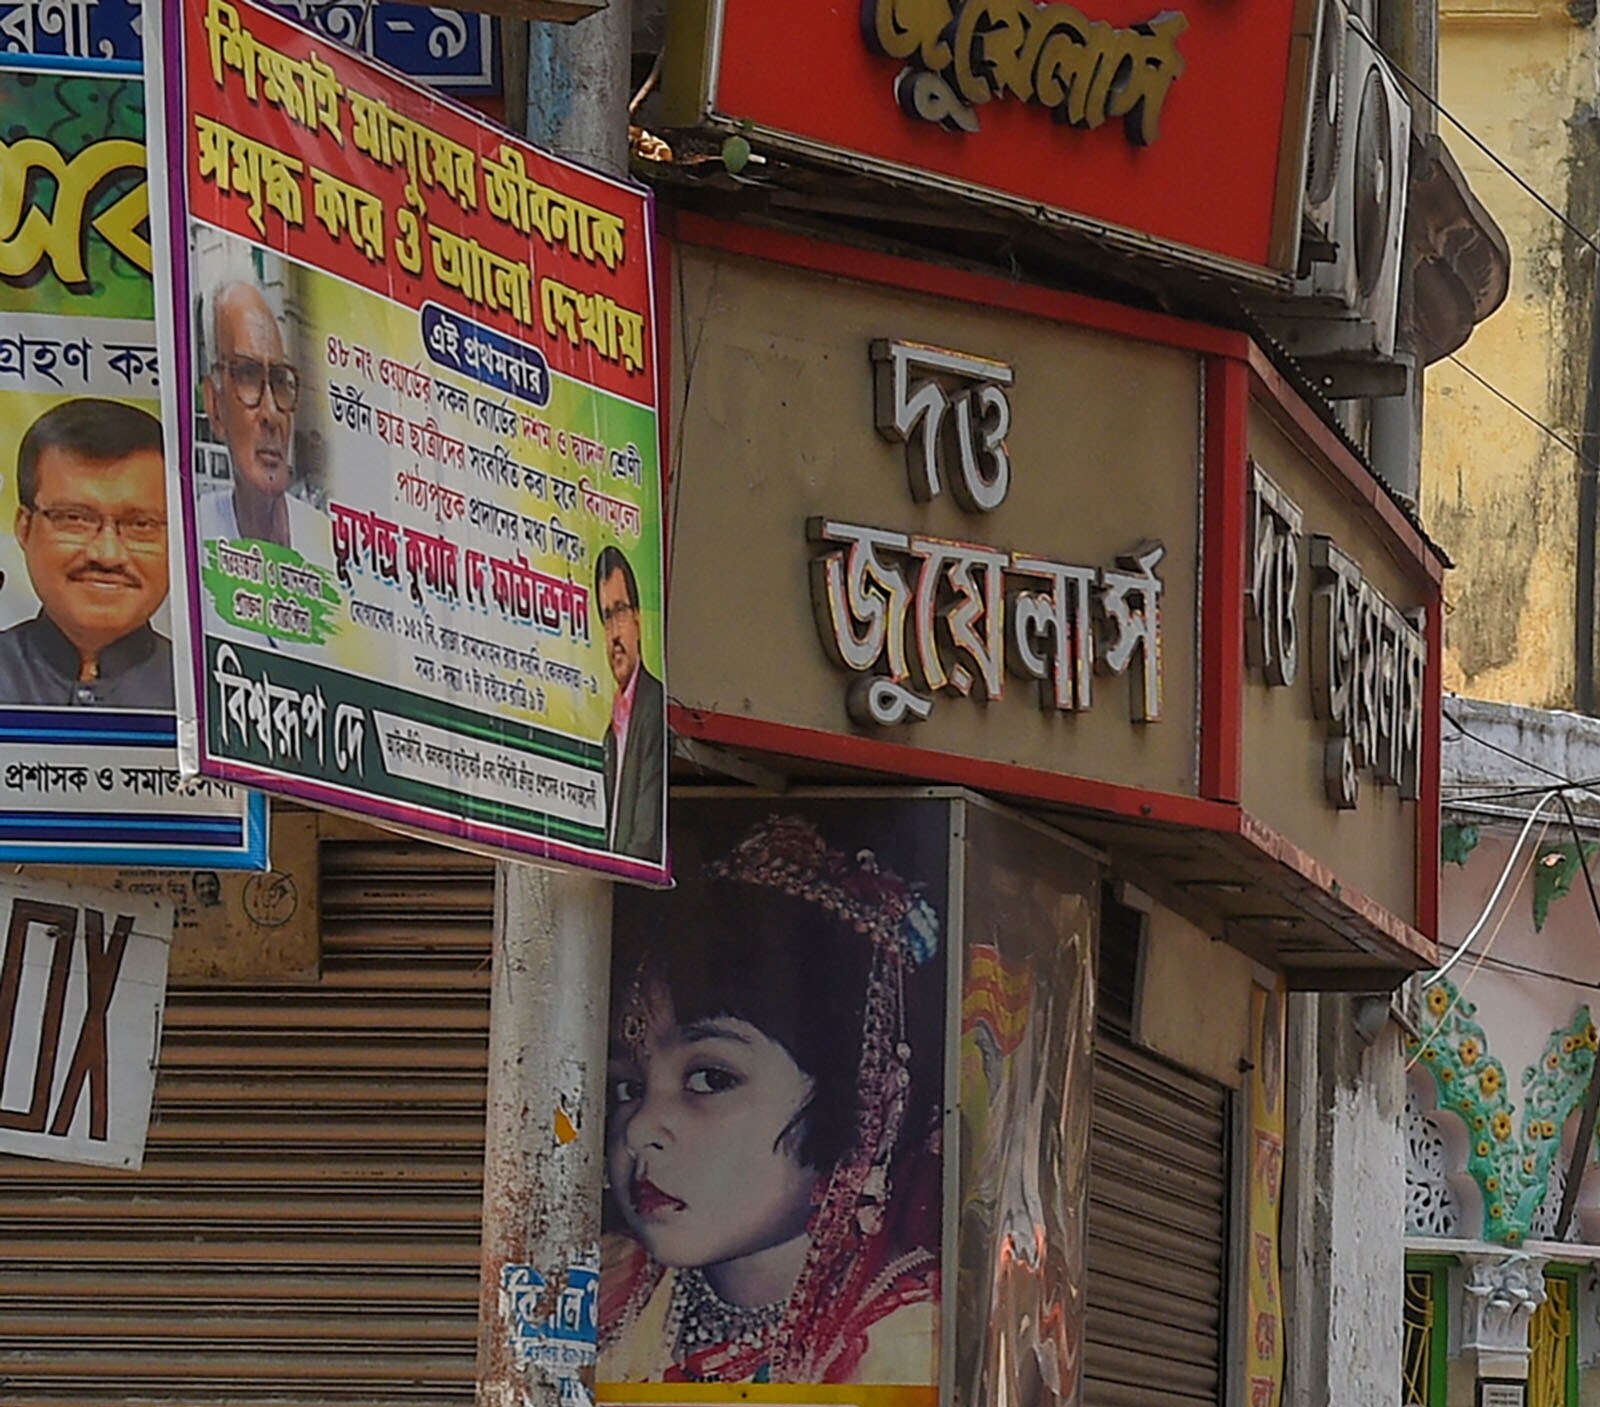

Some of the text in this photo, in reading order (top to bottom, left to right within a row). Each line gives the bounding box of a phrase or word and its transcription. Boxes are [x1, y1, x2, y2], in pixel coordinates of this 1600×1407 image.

[204, 0, 344, 148] শিক্ষাই
[347, 88, 478, 215] মানুষের
[482, 145, 625, 270] জীবনকে
[194, 113, 645, 372] সমৃদ্ধ করে ও আলো দেখায়
[326, 335, 350, 367] ৪৮
[353, 343, 374, 381] নং
[434, 379, 469, 420] সকল
[473, 394, 518, 438] বোর্ডের
[556, 431, 567, 458] ও
[429, 318, 542, 394] এই প্রথমবার
[375, 409, 406, 448] ছাত্র
[408, 418, 466, 471] ছাত্রীদের
[522, 465, 548, 501] করা
[550, 477, 578, 513] হবে
[871, 337, 1015, 514] দত্ত
[402, 526, 459, 607] কুমার
[465, 548, 486, 609] দে
[468, 497, 519, 541] প্রদানের
[808, 516, 1166, 726] জুয়েলার্স
[213, 643, 364, 777] বিশ্বরূপ দে
[4, 762, 88, 795] প্রশাসক
[95, 766, 113, 791] ও
